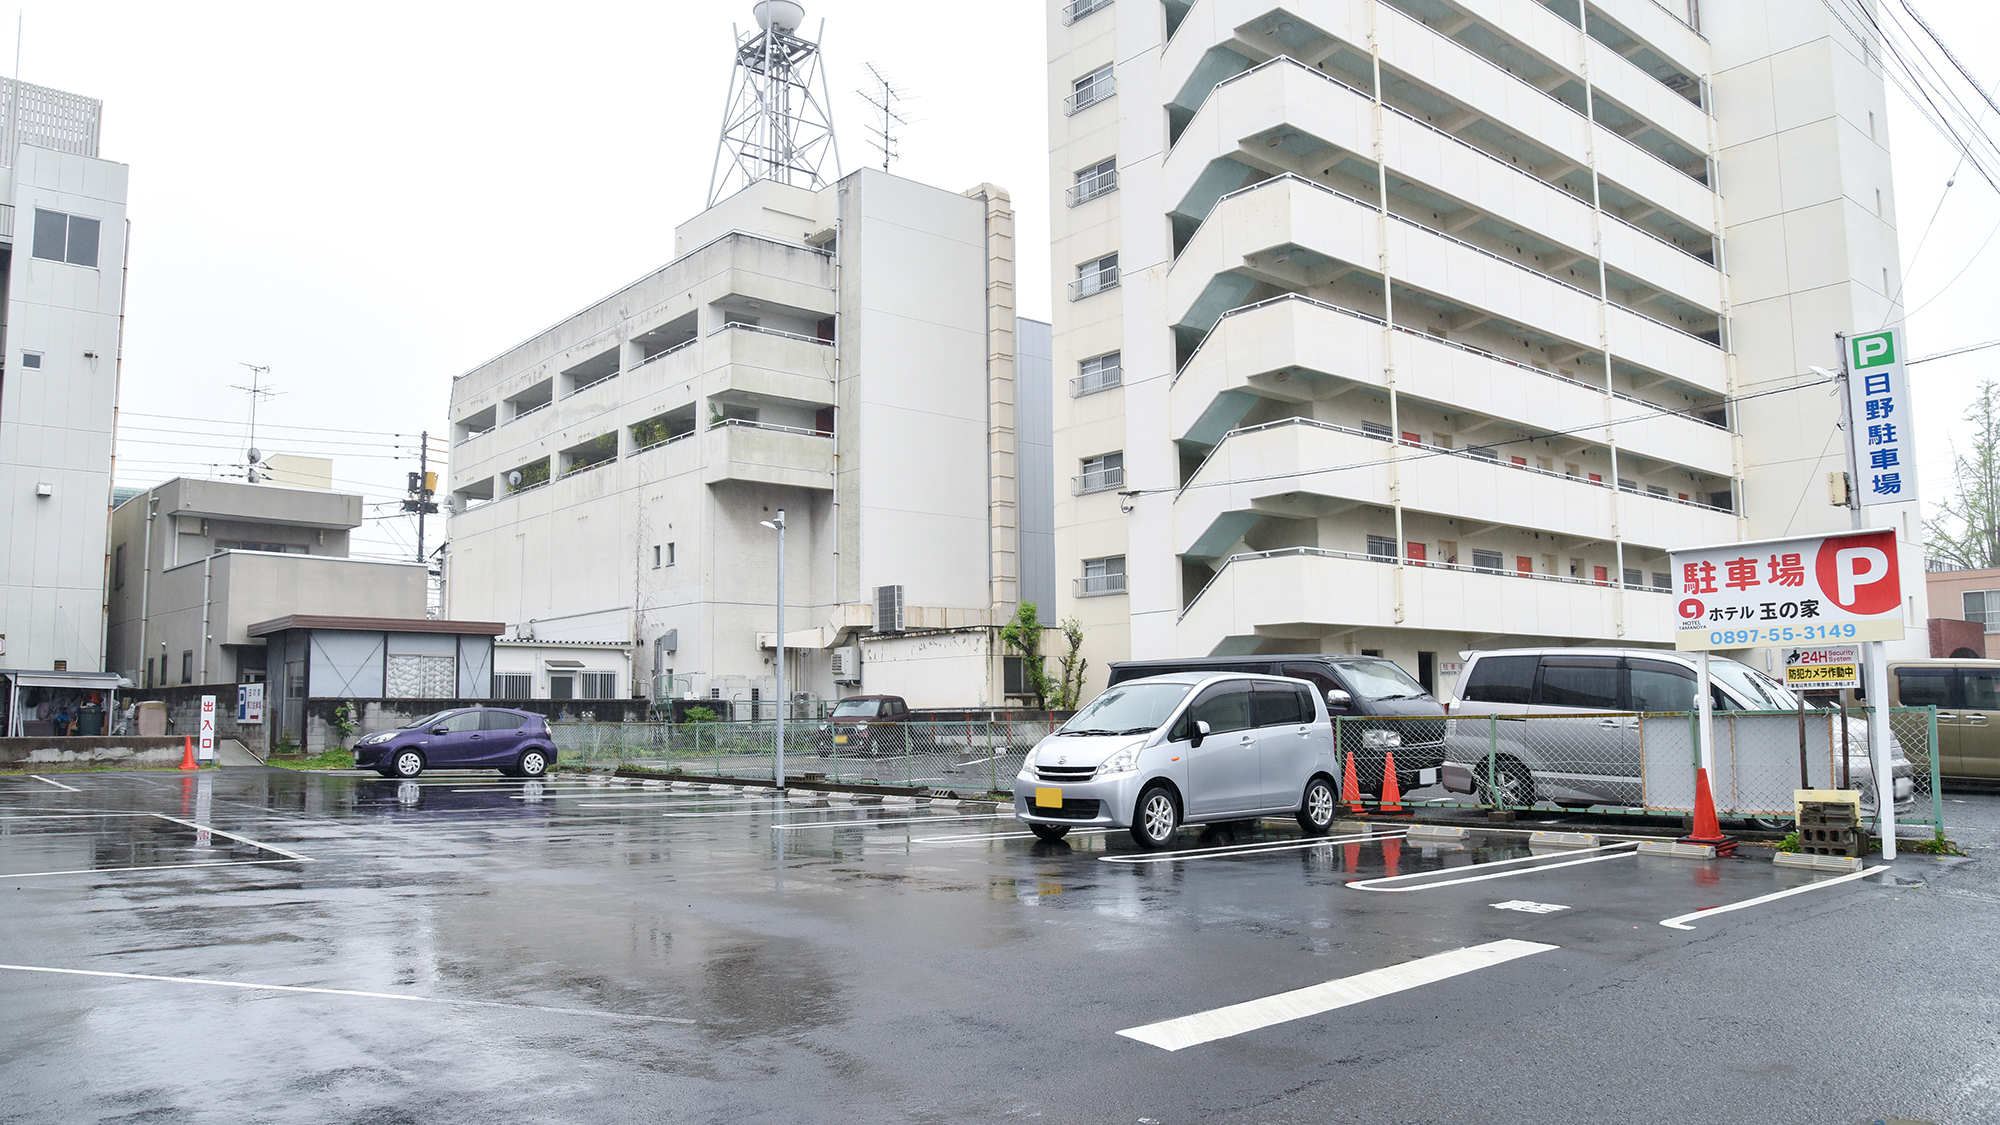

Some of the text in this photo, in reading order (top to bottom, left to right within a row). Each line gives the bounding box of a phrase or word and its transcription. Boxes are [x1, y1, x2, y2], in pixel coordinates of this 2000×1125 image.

[1857, 336, 1888, 366] P
[1864, 372, 1902, 496] 日野駐車場
[1683, 553, 1805, 595] 駐車場
[1835, 546, 1889, 606] P
[1709, 599, 1821, 622] ホテル 玉の家
[1710, 623, 1857, 645] 0897-55-3149
[1801, 651, 1828, 663] 24H
[1788, 667, 1854, 680] 防犯カメラ作動中
[201, 701, 214, 749] 出入口
